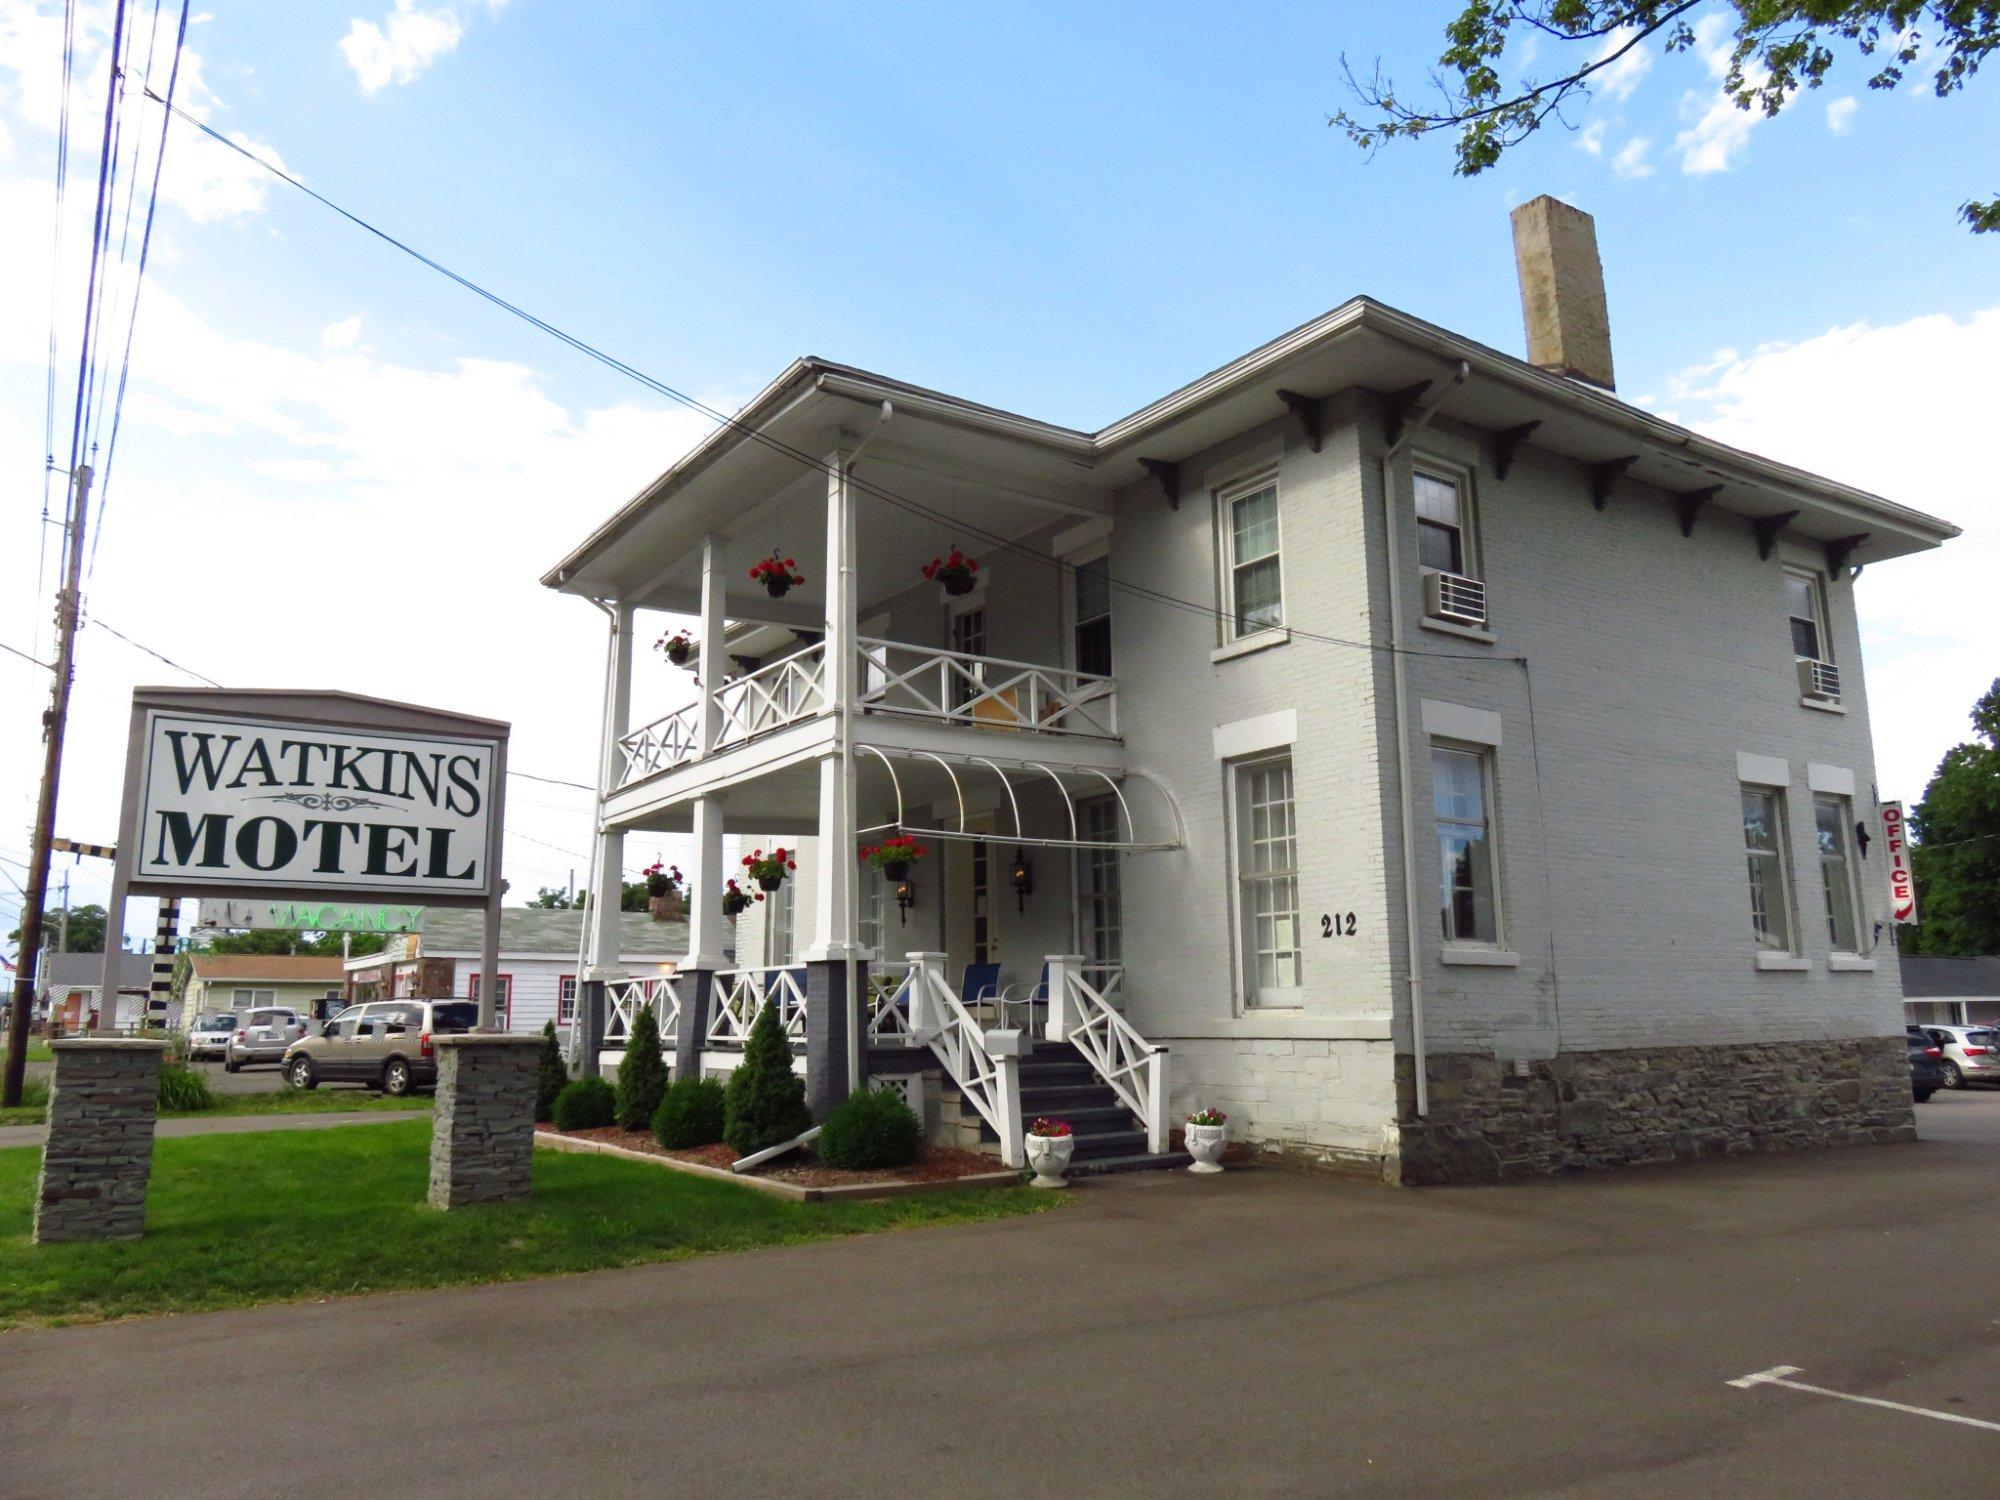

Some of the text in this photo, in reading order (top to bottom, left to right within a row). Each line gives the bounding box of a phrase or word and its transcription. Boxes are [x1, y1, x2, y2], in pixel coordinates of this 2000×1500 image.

[165, 730, 481, 817] WATKINS
[150, 810, 476, 880] MOTEL
[1883, 808, 1910, 899] OFFICE
[270, 903, 424, 930] VACANCY
[1320, 911, 1357, 938] 212
